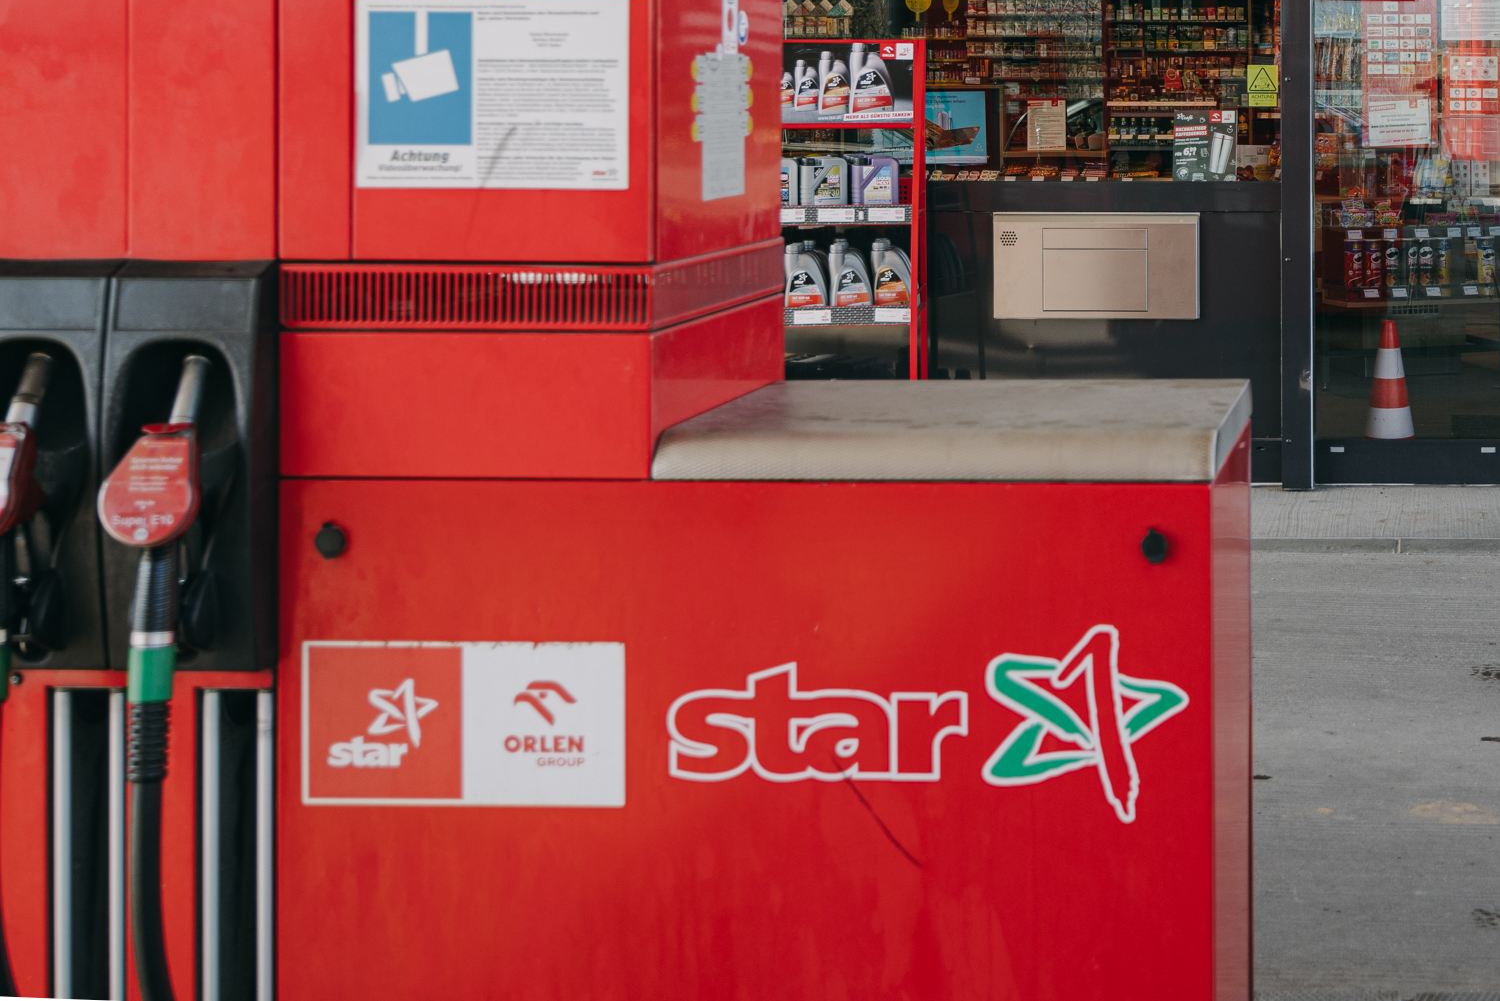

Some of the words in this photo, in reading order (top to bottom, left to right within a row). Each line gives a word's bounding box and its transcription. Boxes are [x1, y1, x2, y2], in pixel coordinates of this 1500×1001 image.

[390, 150, 450, 164] Achtung
[817, 188, 840, 196] 5W-30
[112, 515, 147, 528] Super
[150, 514, 174, 526] E10
[666, 661, 969, 782] star
[503, 735, 585, 754] ORLEN
[326, 736, 408, 768] star
[536, 756, 586, 768] GROUP
